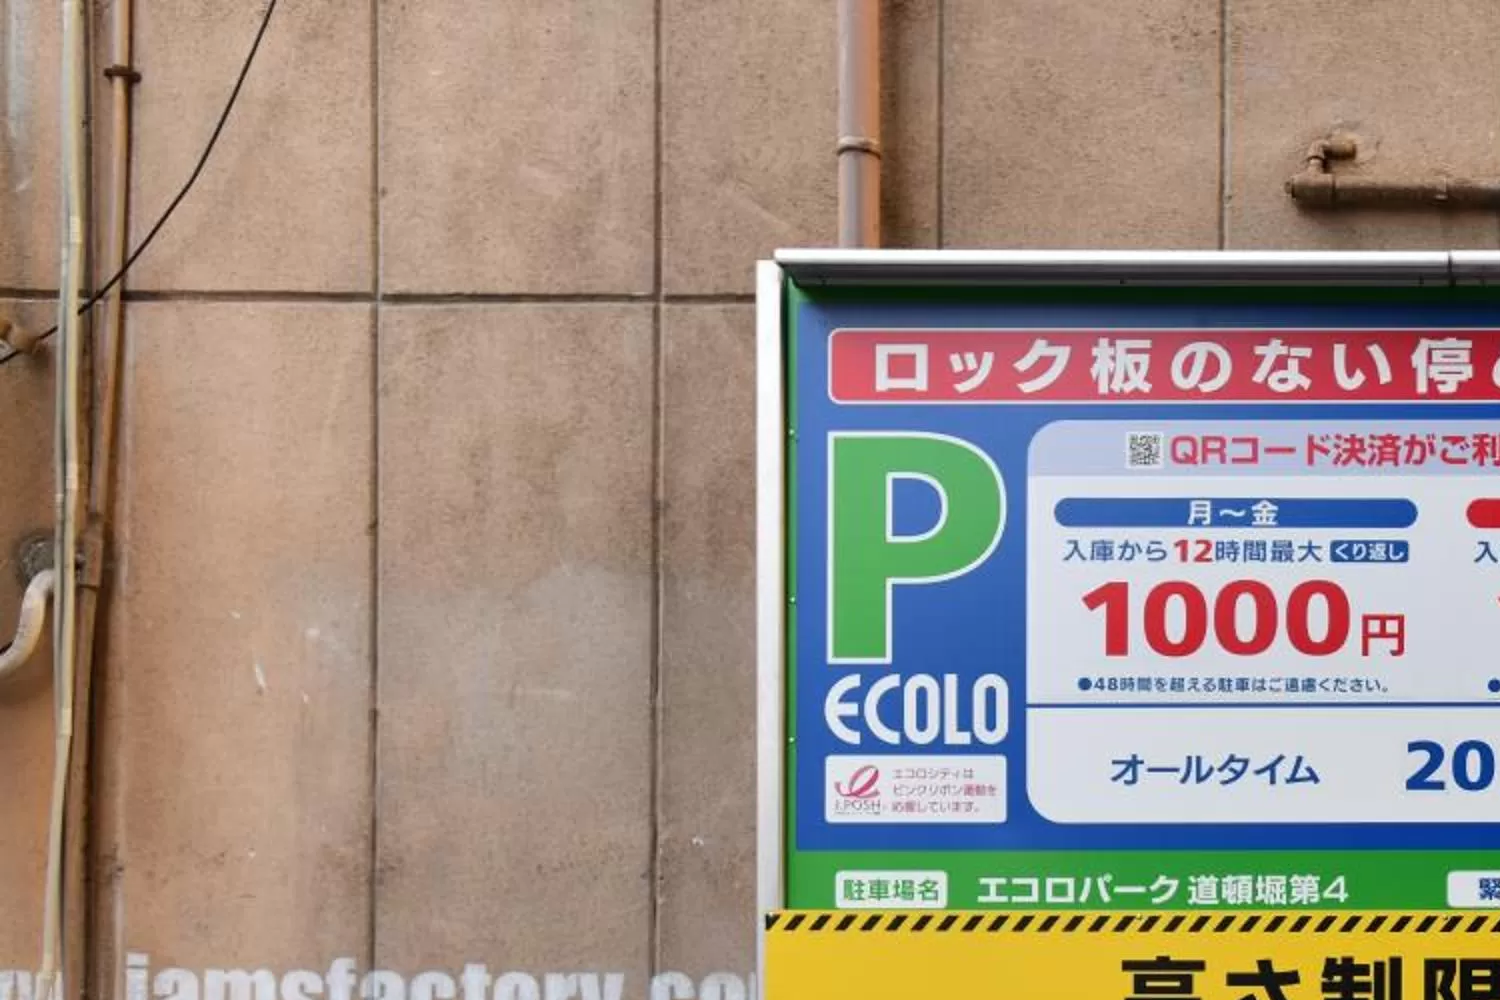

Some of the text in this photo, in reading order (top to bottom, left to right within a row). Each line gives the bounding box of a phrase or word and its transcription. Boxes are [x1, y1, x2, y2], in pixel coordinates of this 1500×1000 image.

[826, 430, 1008, 666] P
[824, 674, 1008, 744] ECOLO
[1111, 754, 1320, 785] オールタイム
[844, 879, 938, 901] 駐車場名
